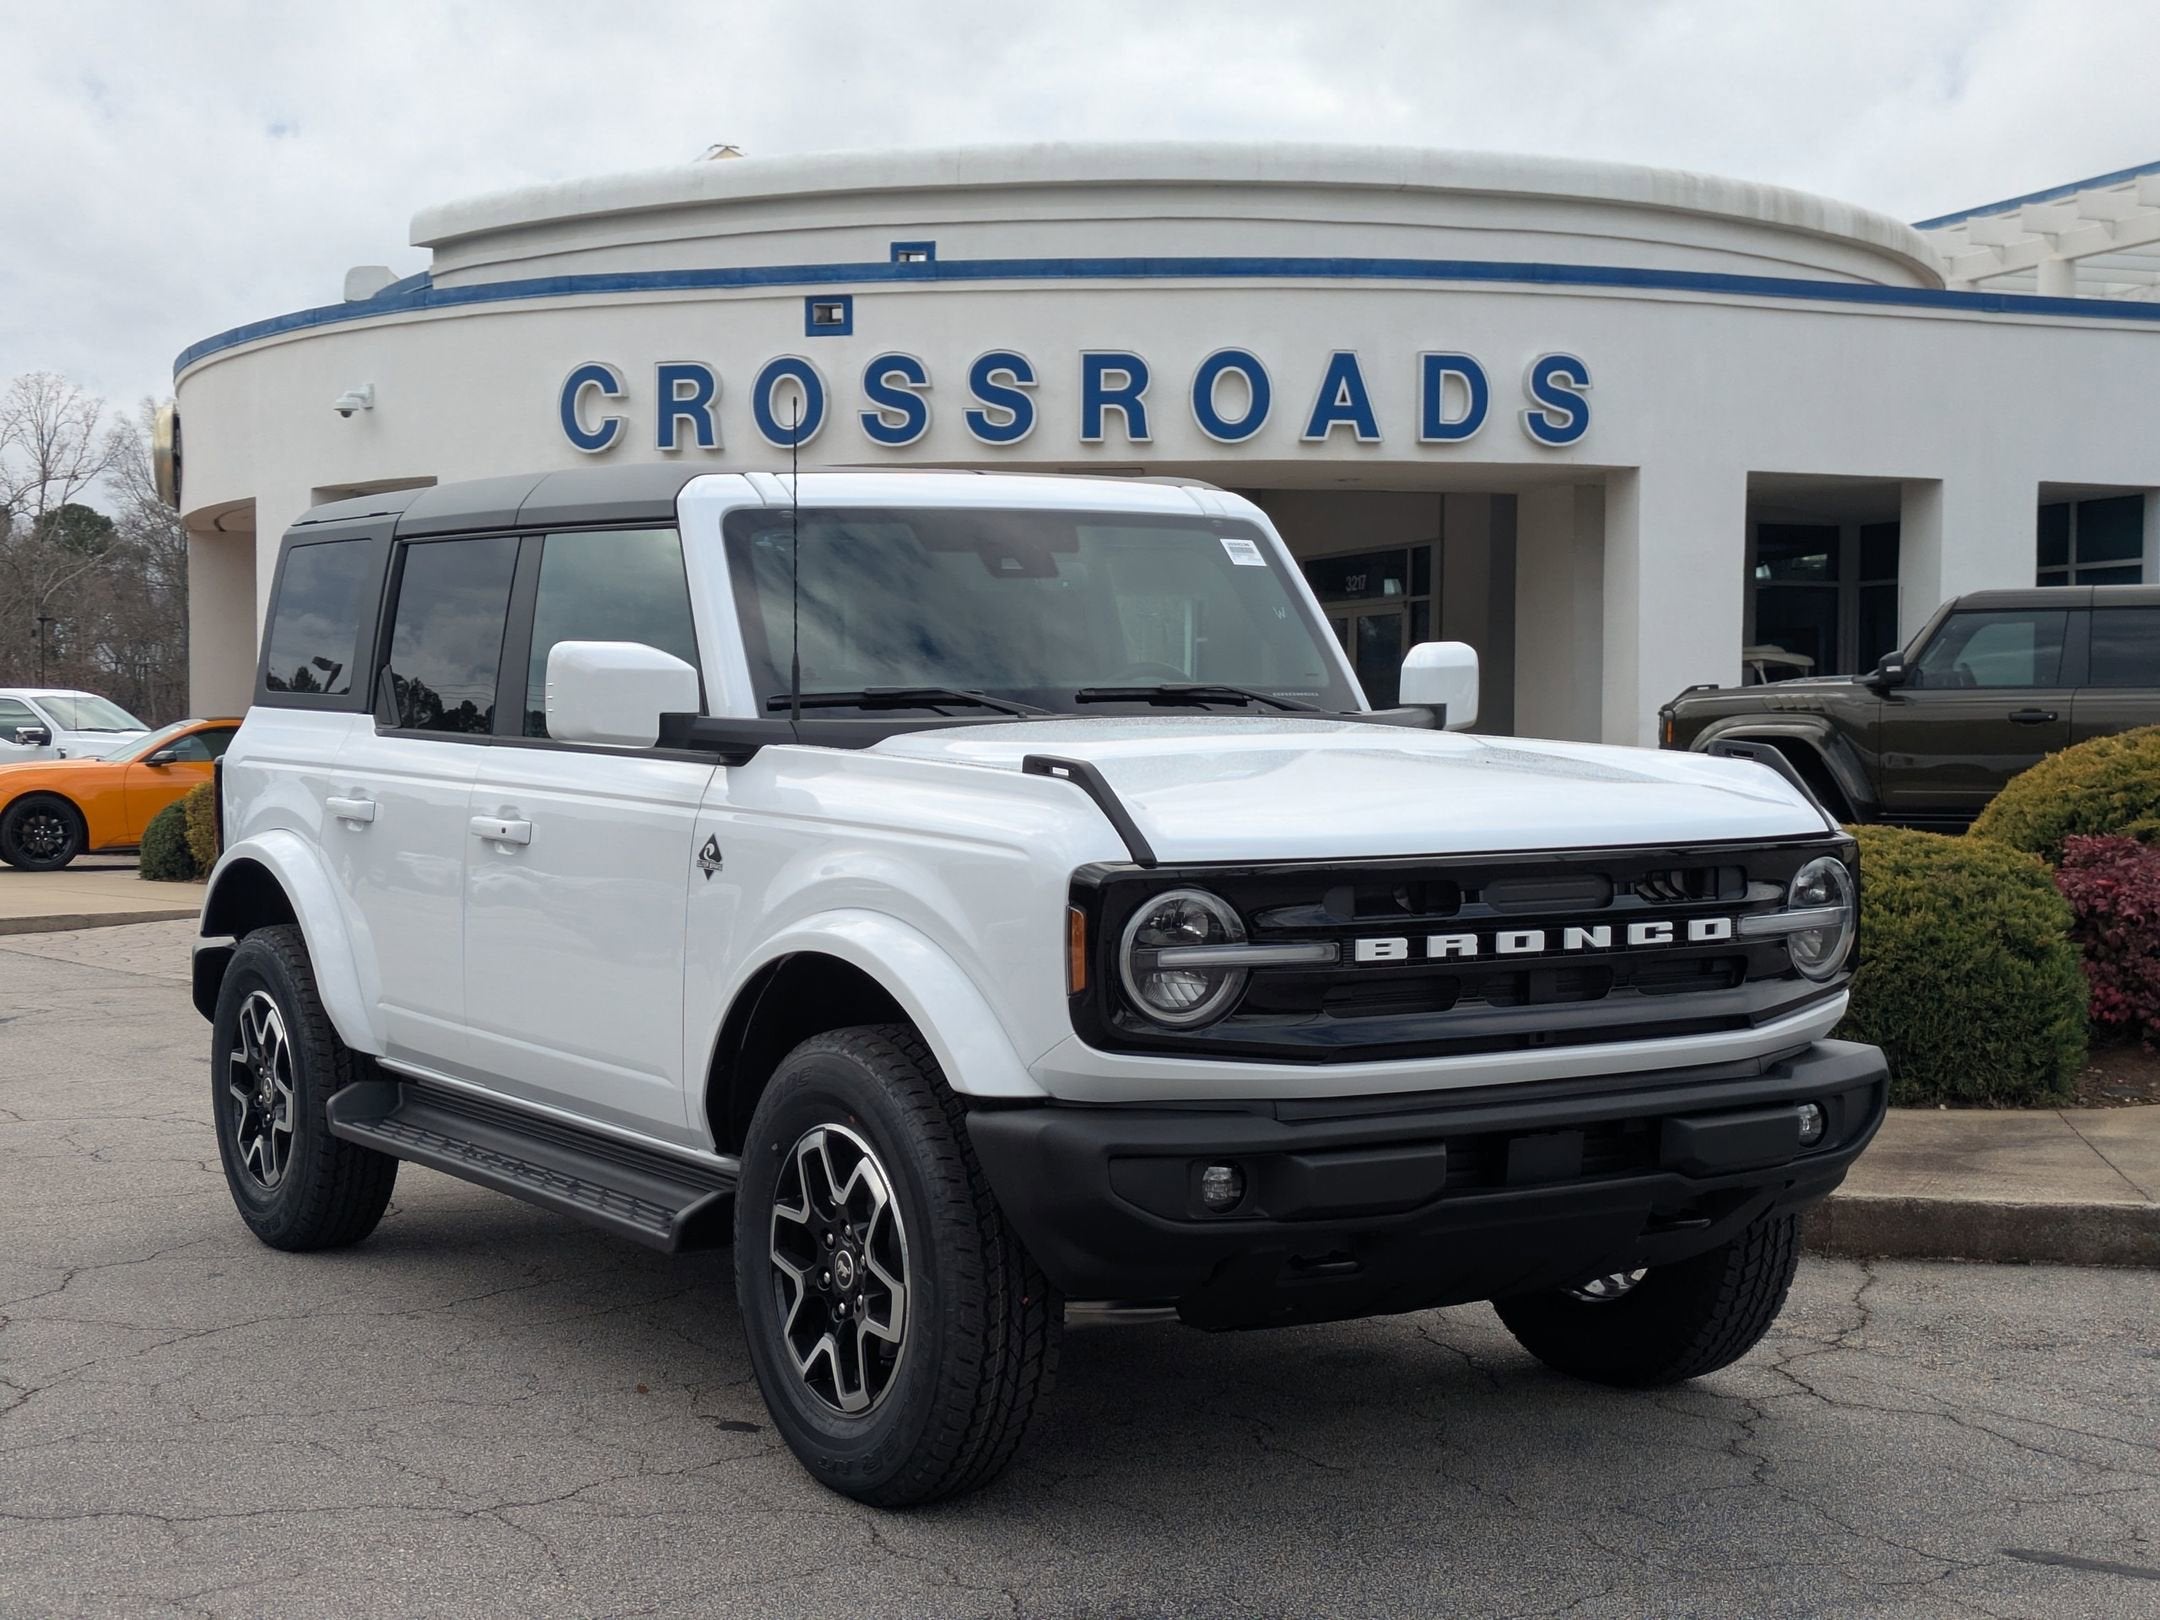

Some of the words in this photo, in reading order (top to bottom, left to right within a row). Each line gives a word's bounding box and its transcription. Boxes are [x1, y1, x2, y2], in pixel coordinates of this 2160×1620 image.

[560, 347, 1592, 453] CROSSROADS
[1345, 574, 1367, 592] 3217
[1355, 917, 1732, 962] BRONCO
